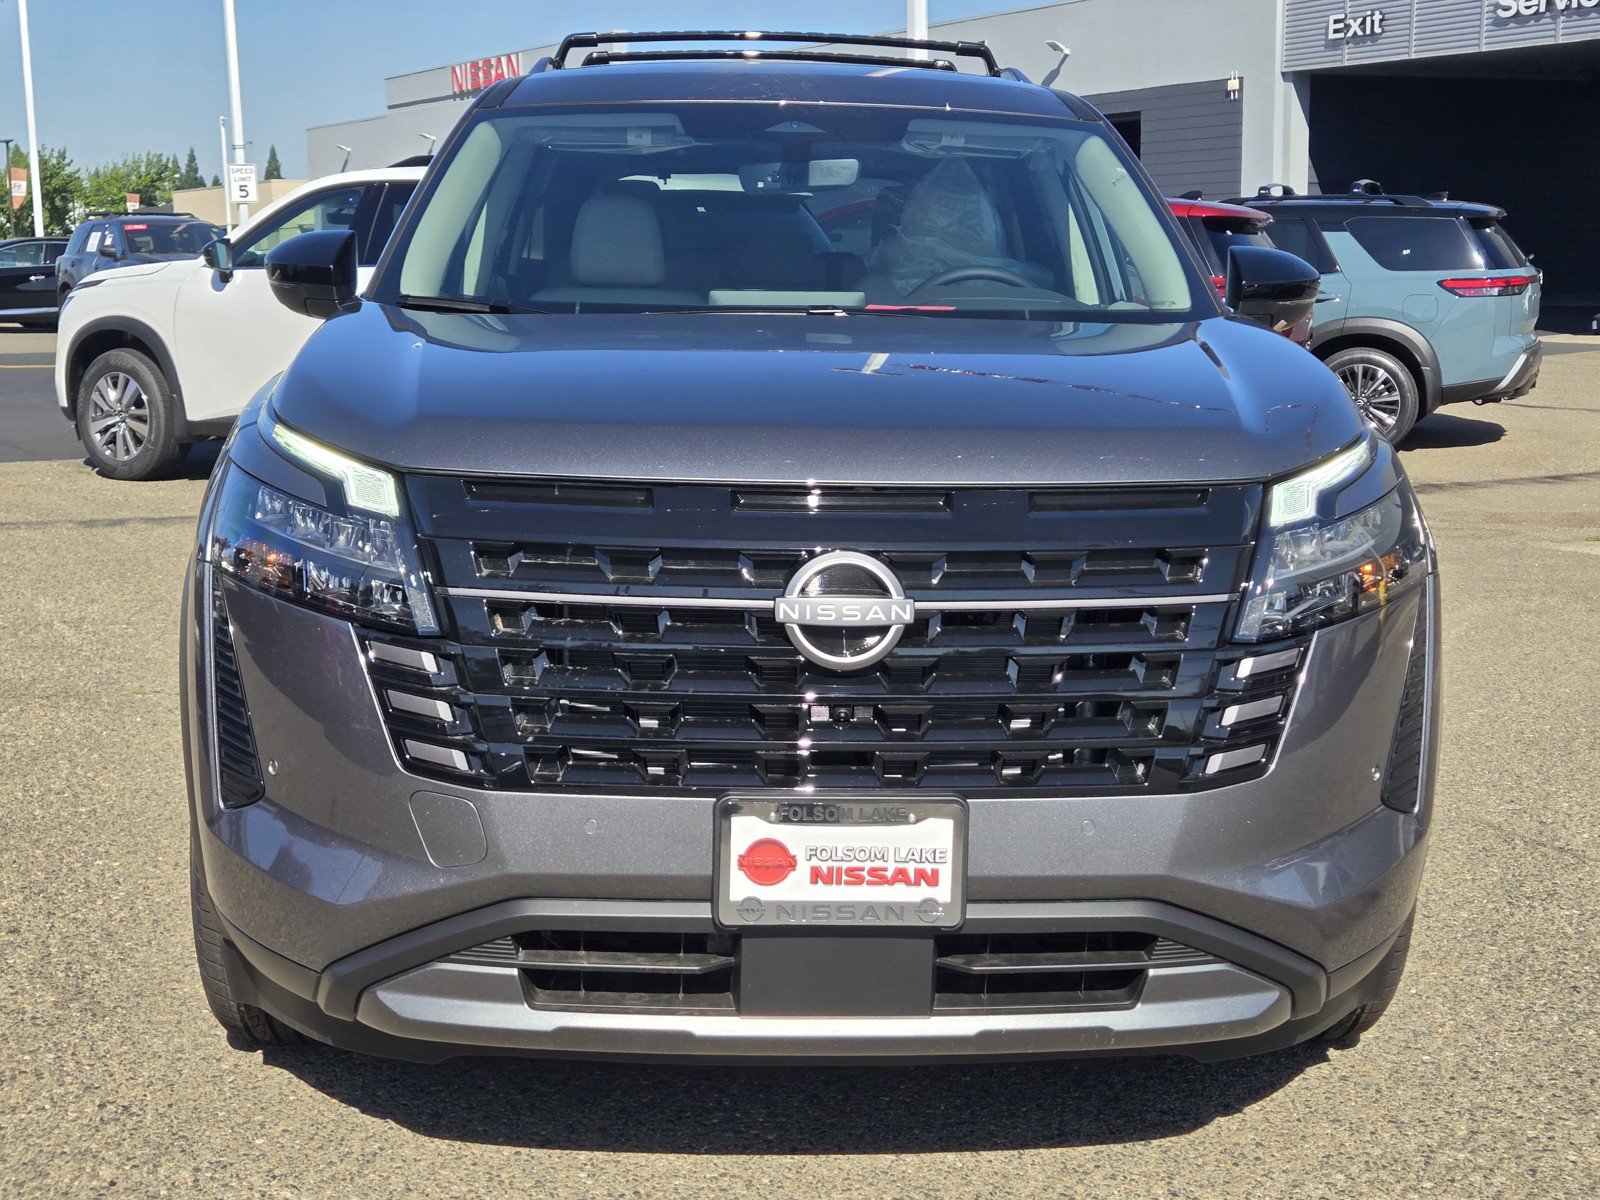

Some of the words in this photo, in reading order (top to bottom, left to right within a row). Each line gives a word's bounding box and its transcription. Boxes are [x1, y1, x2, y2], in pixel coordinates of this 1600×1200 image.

[1328, 10, 1383, 40] Exit
[450, 52, 522, 94] NISSAN
[239, 184, 249, 199] 5
[779, 603, 911, 621] NISSAN
[779, 805, 853, 822] FOLSOM
[858, 807, 907, 822] LAKE
[737, 856, 797, 867] NISSAN
[805, 845, 888, 862] FOLSOM
[894, 848, 947, 864] LAKE
[809, 865, 939, 887] NISSAN
[775, 904, 905, 922] NISSAN
